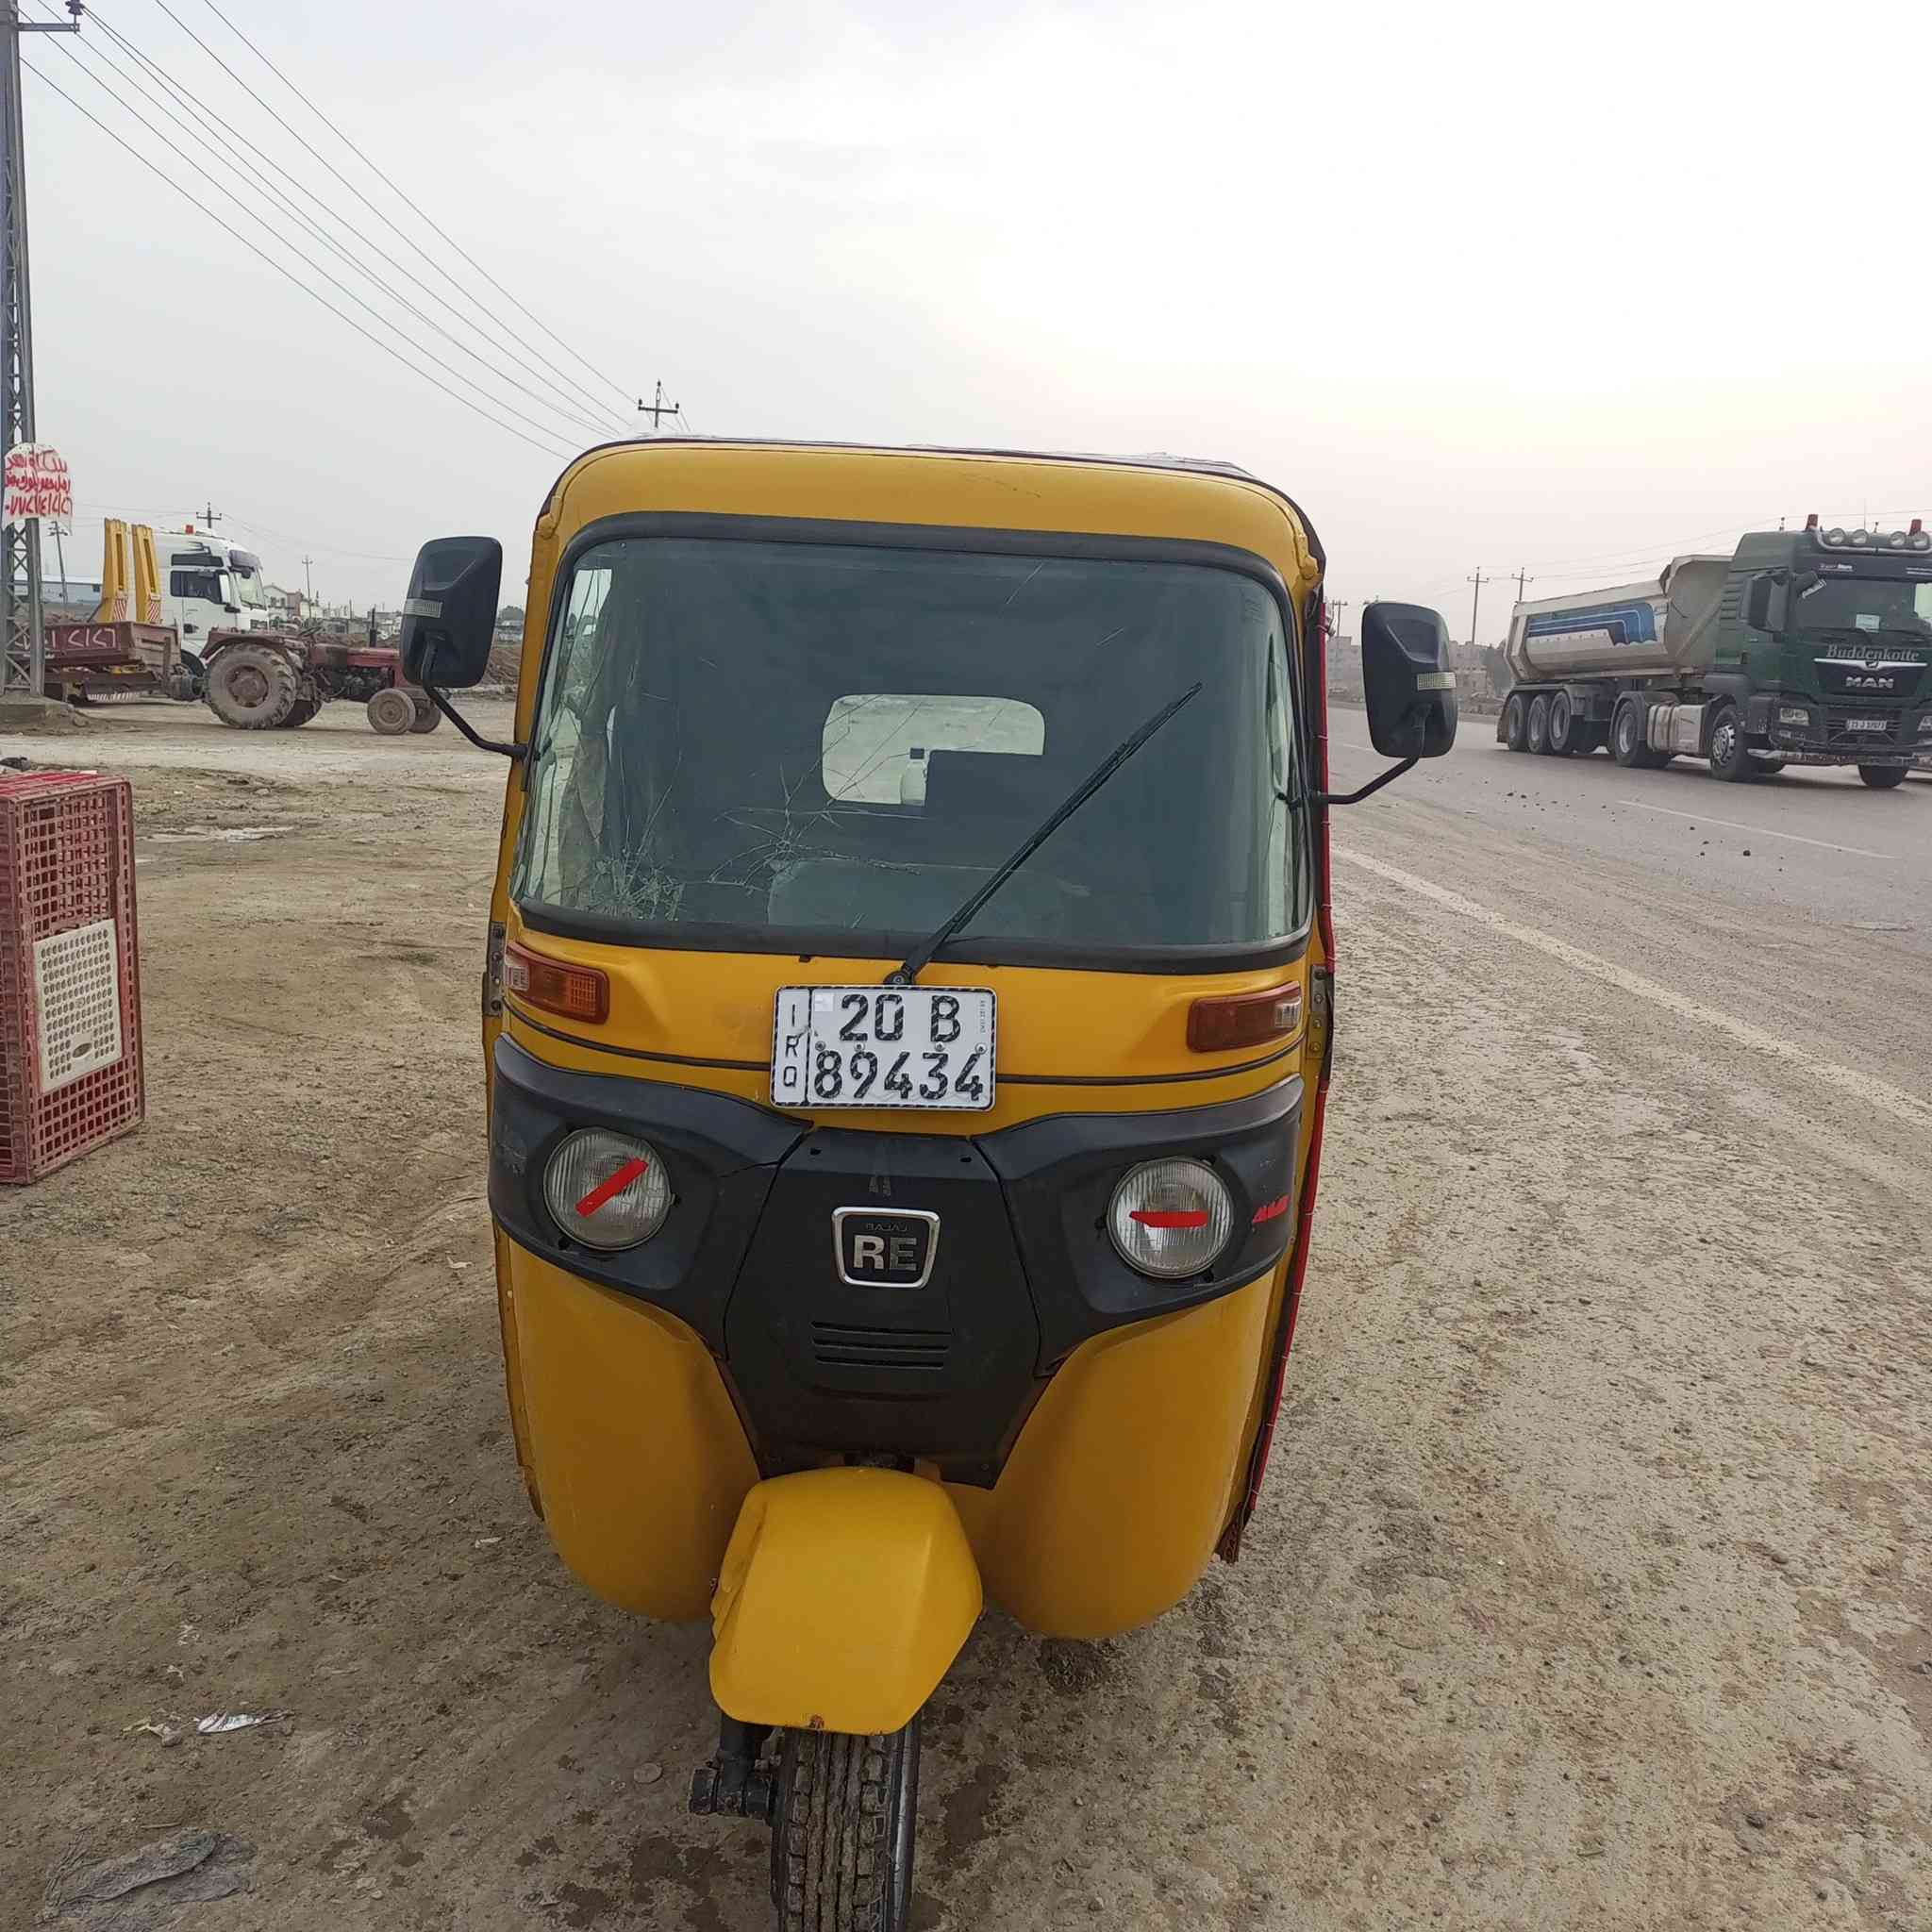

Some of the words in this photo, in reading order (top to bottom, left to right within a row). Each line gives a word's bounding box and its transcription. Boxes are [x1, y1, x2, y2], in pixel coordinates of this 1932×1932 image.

[1826, 644, 1920, 661] Buddenkotte
[1845, 676, 1894, 689] MAN
[840, 993, 905, 1041] 20
[929, 994, 961, 1043] B
[813, 1049, 985, 1102] 89434
[853, 1234, 918, 1272] RE
